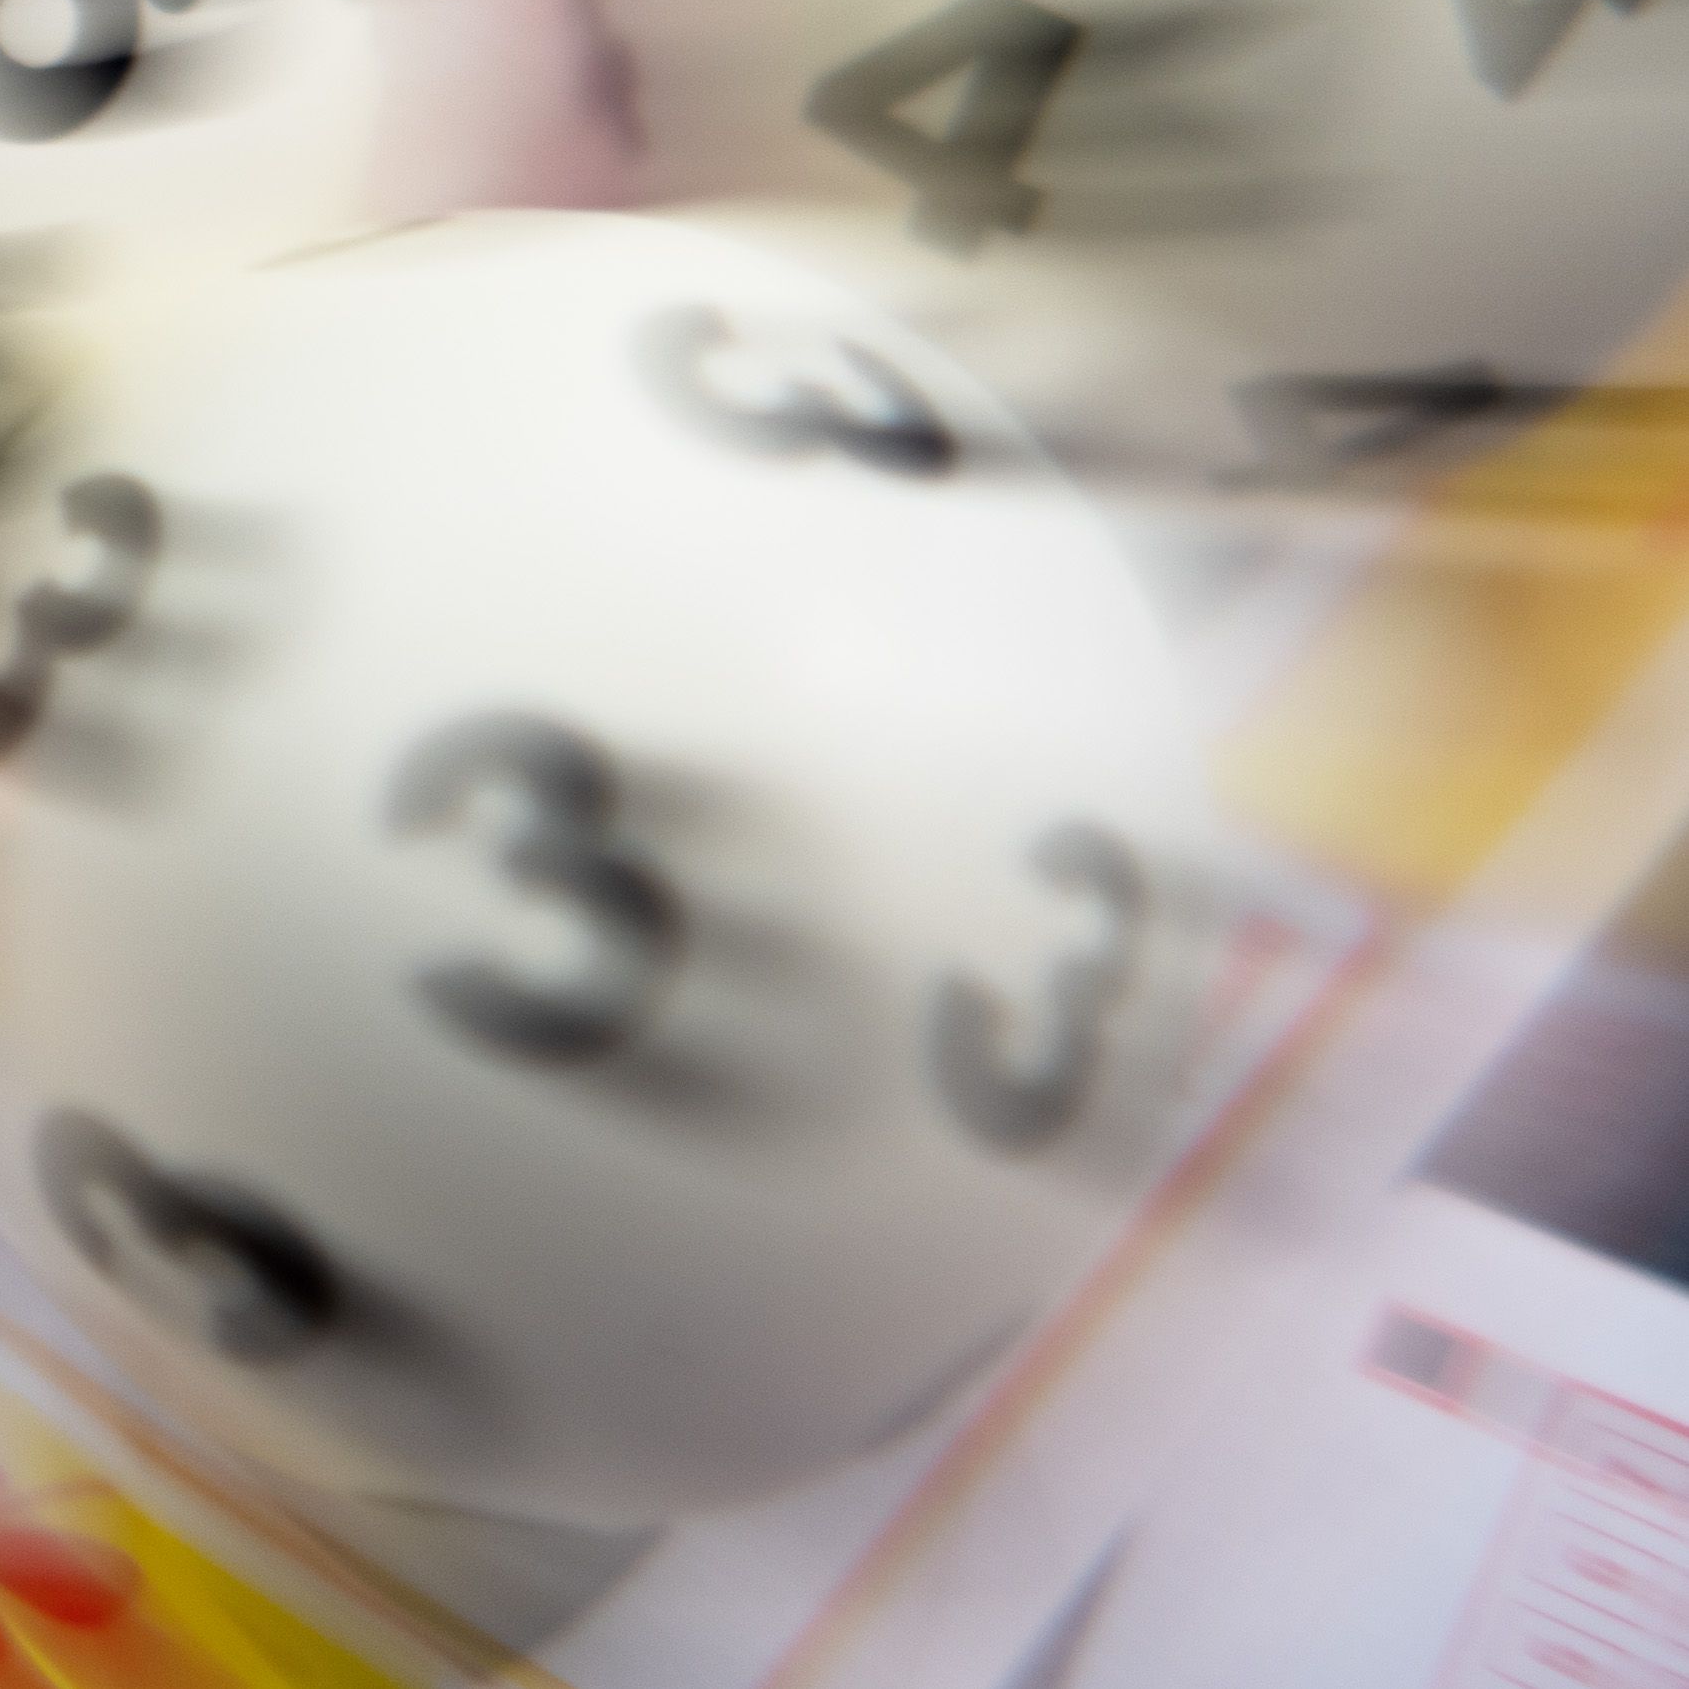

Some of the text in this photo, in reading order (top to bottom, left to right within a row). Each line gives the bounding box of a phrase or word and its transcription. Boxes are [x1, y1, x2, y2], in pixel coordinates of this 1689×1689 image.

[384, 709, 692, 1073] 3
[930, 819, 1150, 1153] 3
[30, 1104, 344, 1366] 3
